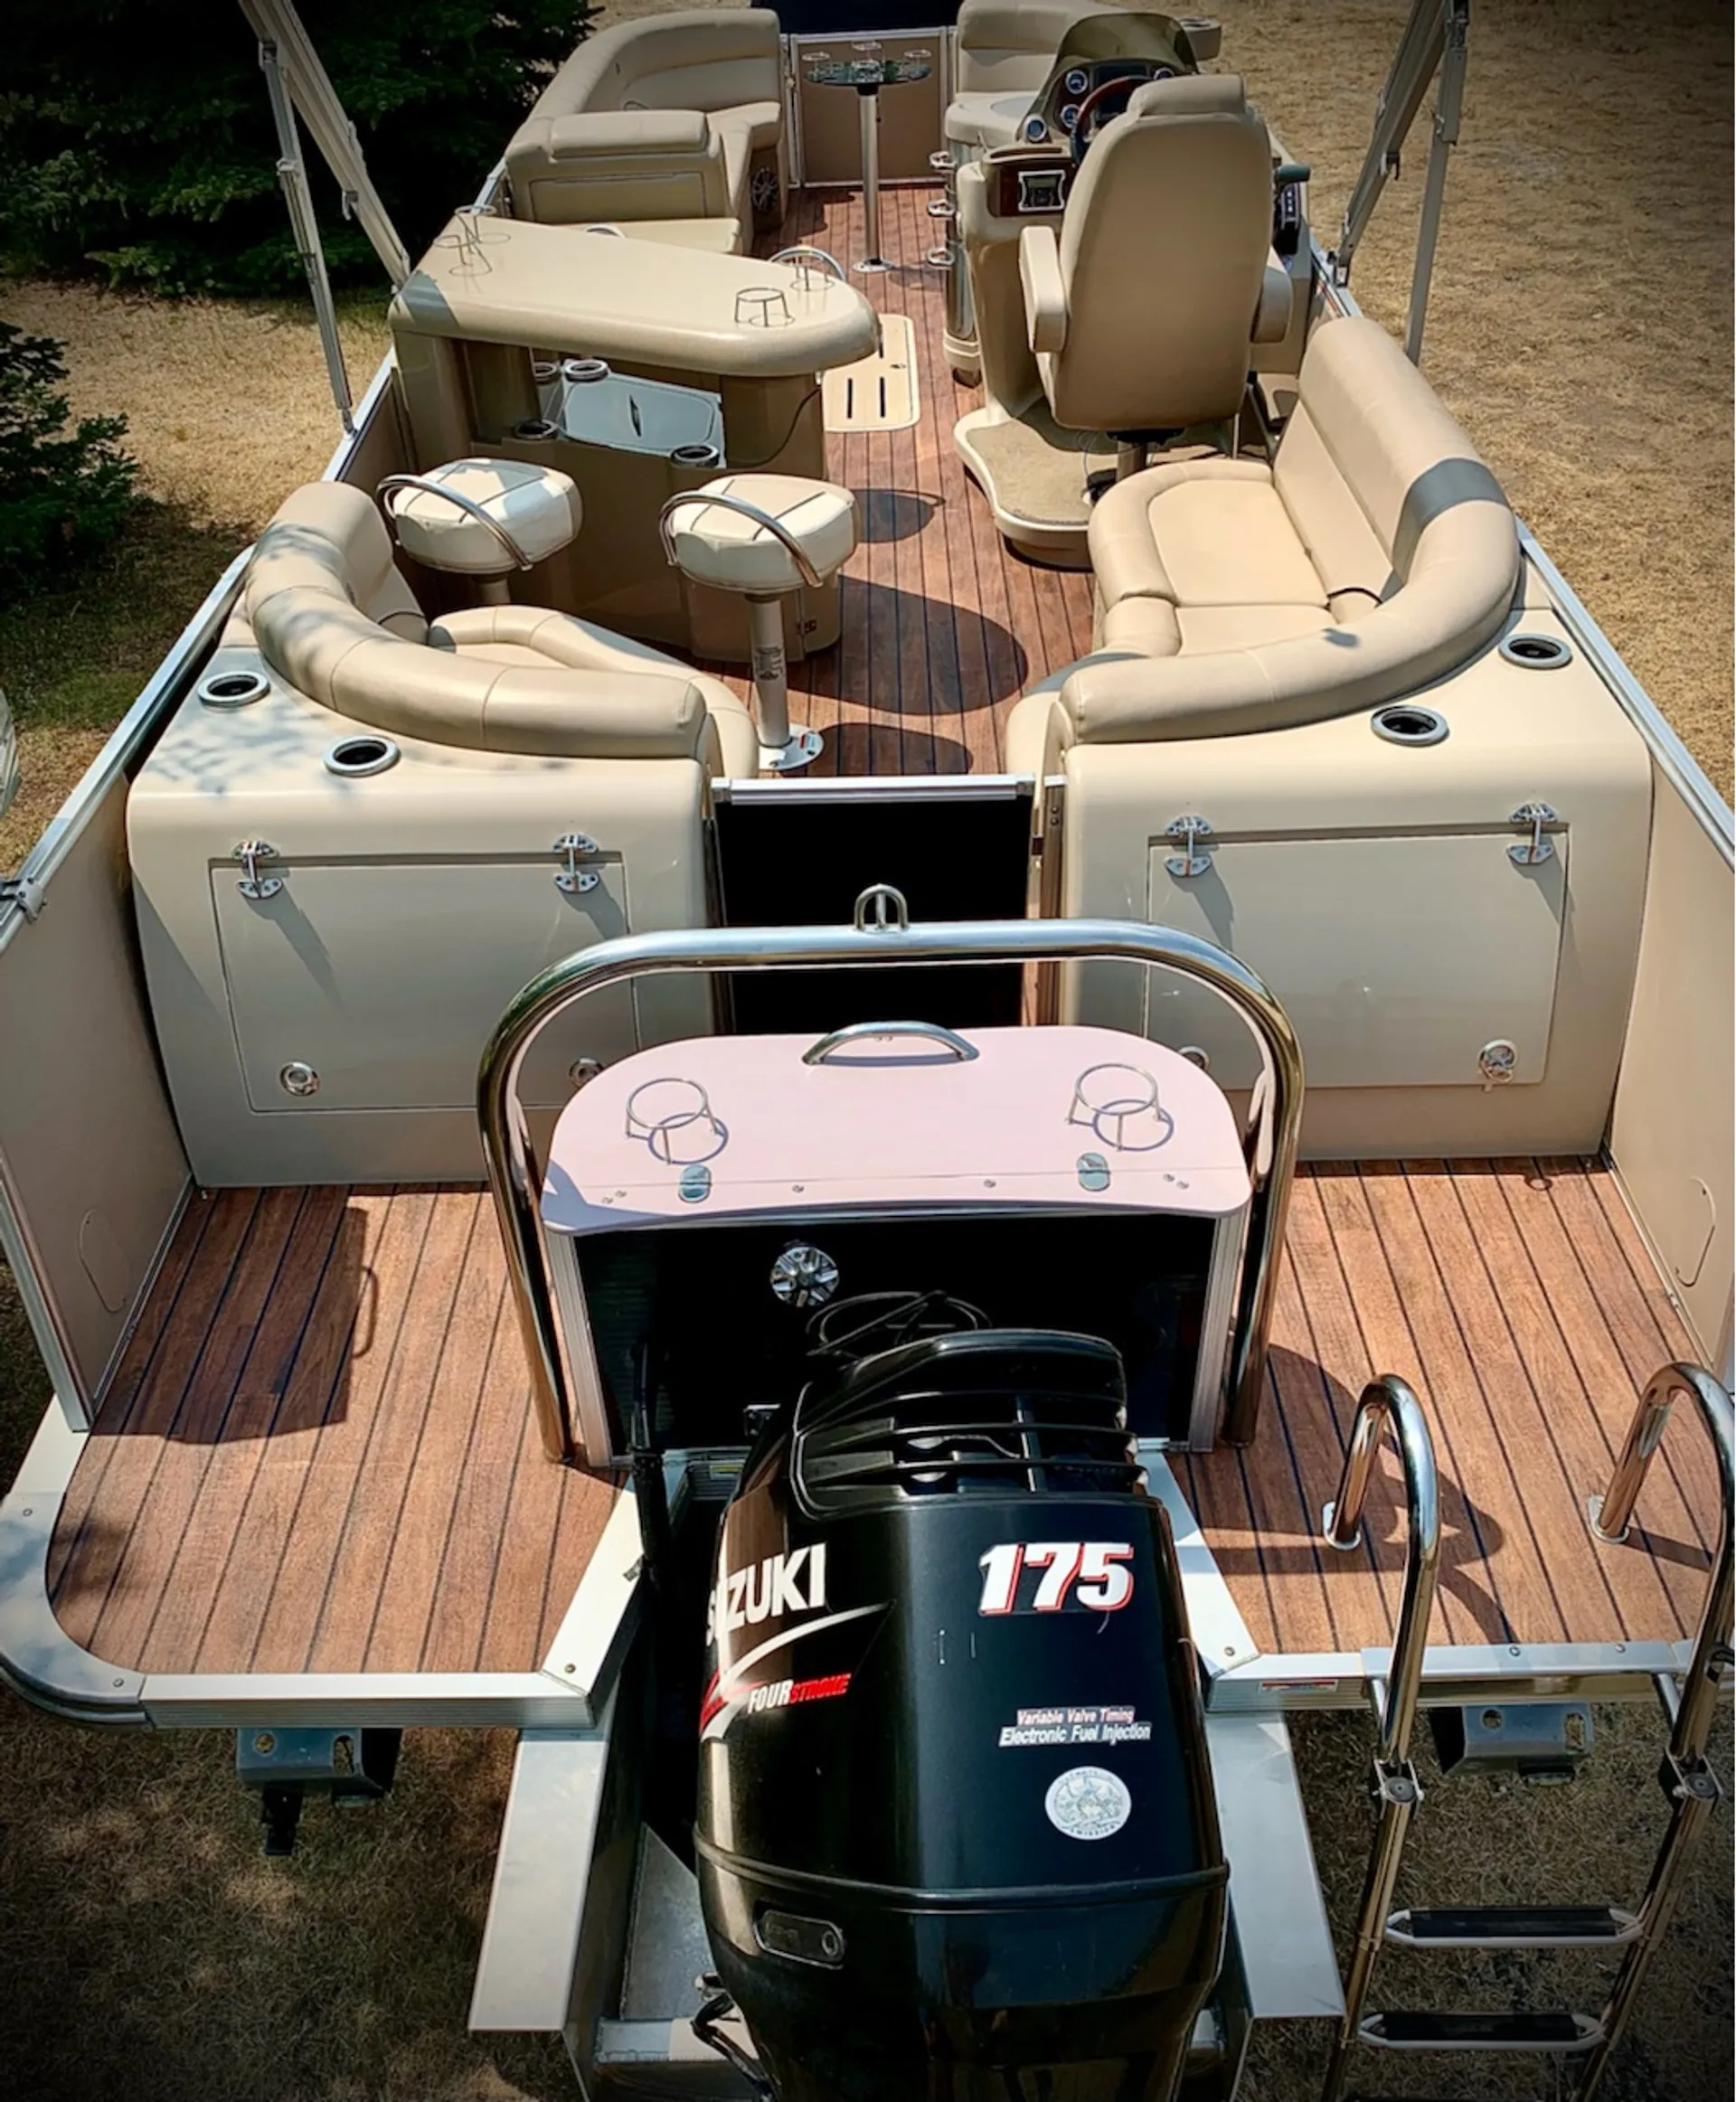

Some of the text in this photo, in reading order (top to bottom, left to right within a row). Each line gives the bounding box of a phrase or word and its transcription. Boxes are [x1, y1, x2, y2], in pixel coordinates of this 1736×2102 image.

[979, 1541, 1135, 1617] 175
[1017, 1706, 1136, 1725] Variable Valve Timing
[998, 1722, 1152, 1747] Electronic Fuel Injection
